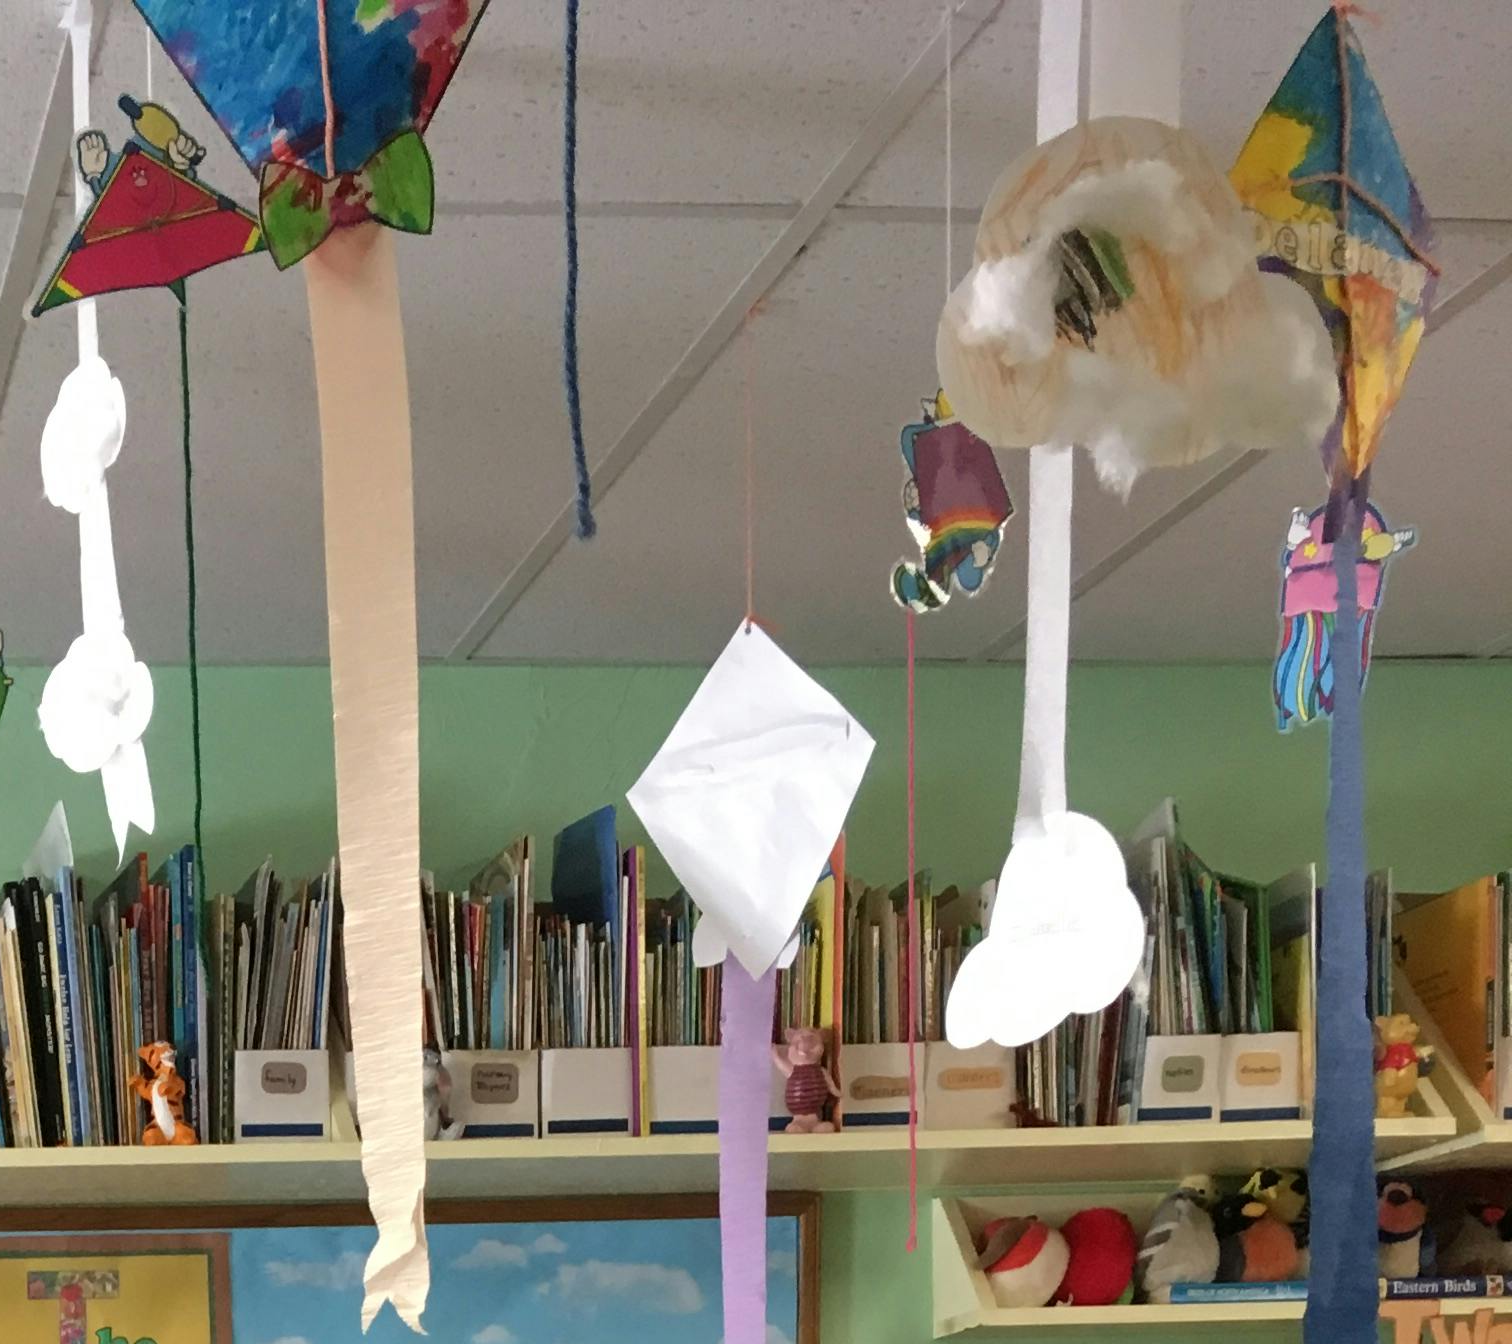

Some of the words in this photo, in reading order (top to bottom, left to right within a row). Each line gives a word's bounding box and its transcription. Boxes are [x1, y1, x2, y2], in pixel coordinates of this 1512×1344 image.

[265, 1069, 297, 1089] Family
[1392, 1280, 1439, 1294] Eastern
[1444, 1279, 1477, 1293] Birds
